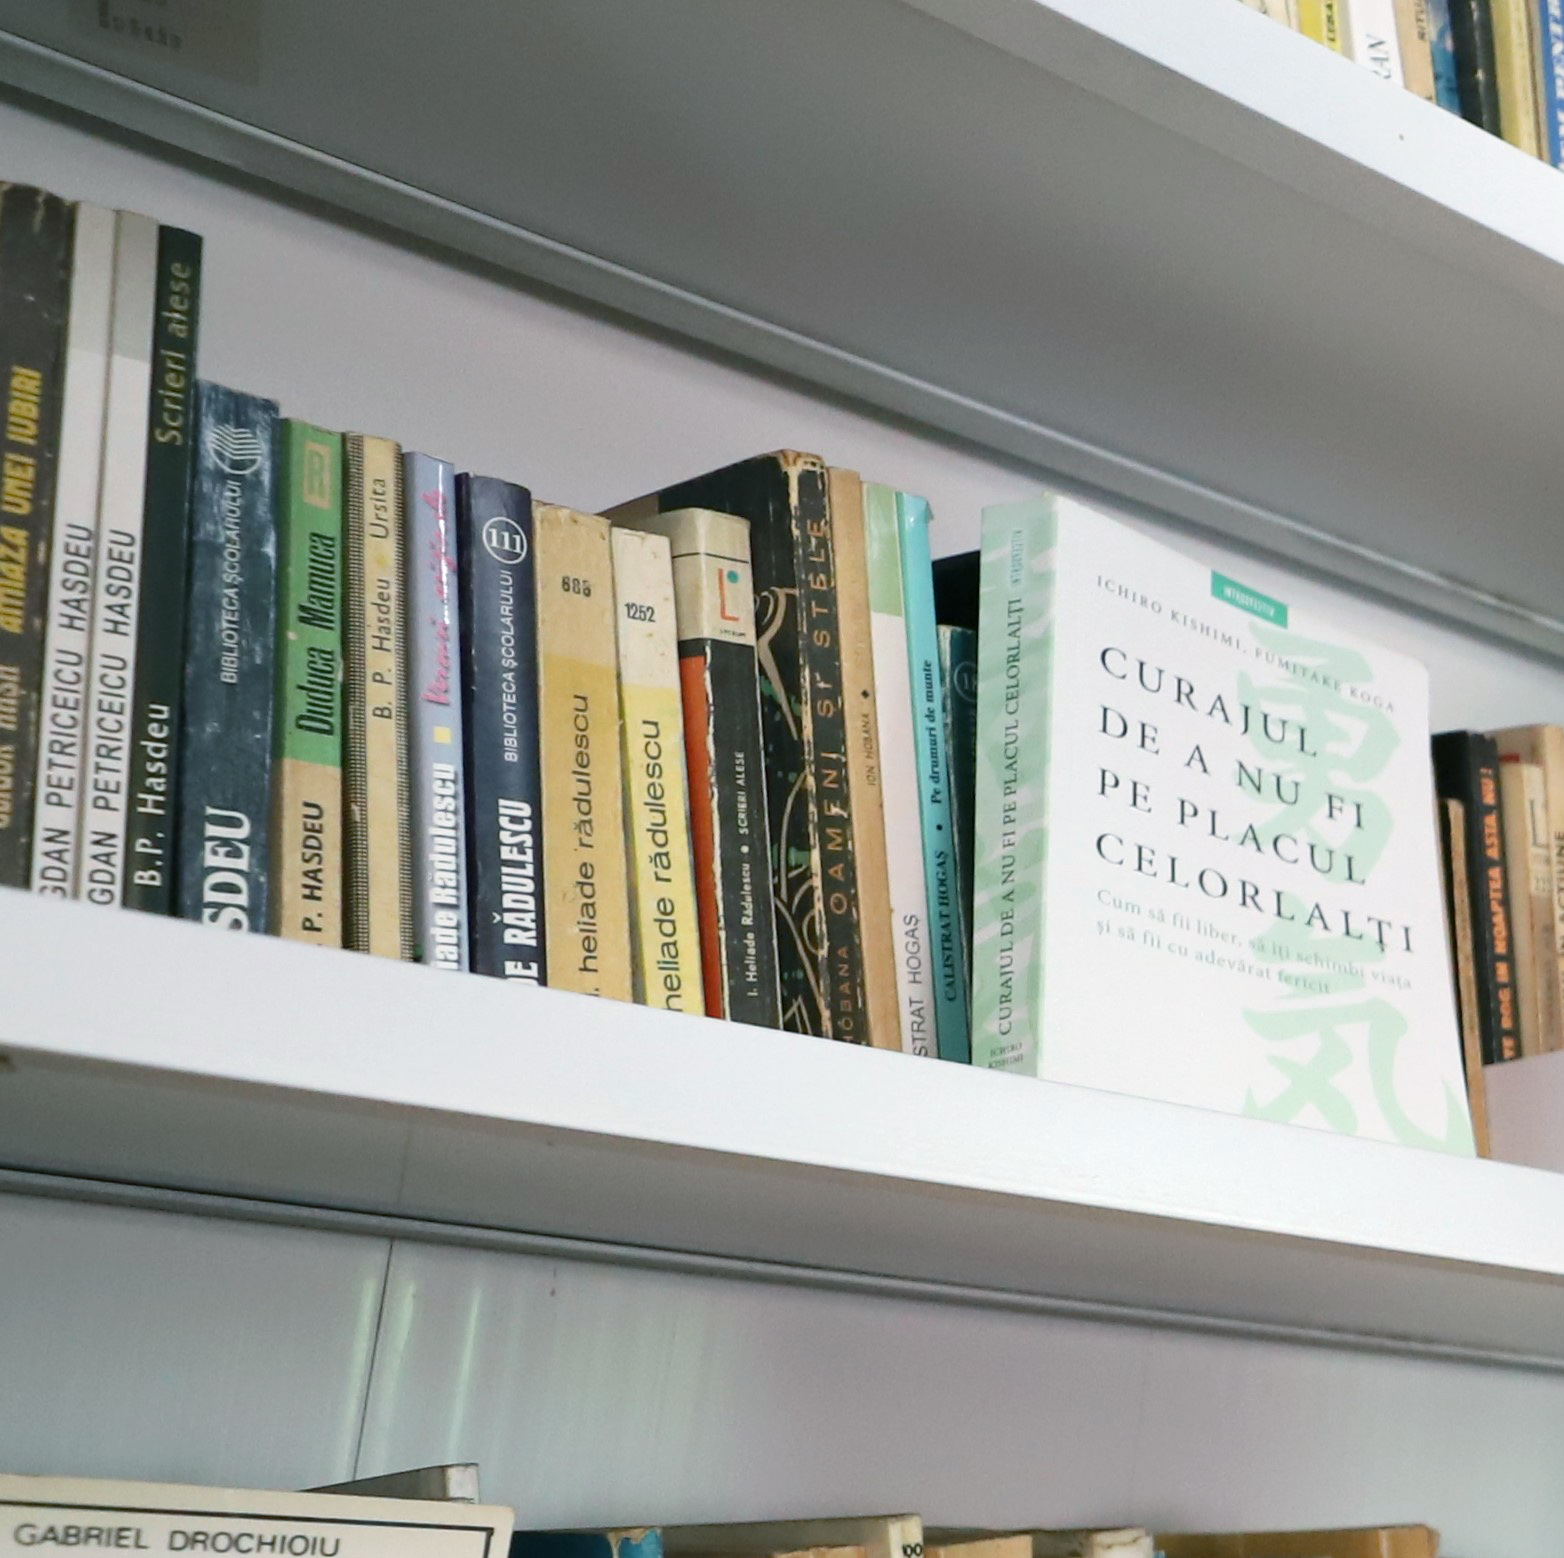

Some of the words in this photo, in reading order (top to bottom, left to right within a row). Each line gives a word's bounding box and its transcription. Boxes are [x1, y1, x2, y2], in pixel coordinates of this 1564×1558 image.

[163, 261, 192, 339] alese
[7, 366, 43, 445] IUBIRI
[154, 350, 187, 446] Scrieri
[367, 477, 390, 540] Ursita
[58, 523, 94, 632] HASDEU
[105, 530, 137, 636] HASDEU
[297, 533, 336, 631] Mamuca
[369, 577, 392, 651] Hasdeu
[623, 601, 658, 624] 1252
[220, 586, 241, 684] BIBLIOTECA
[1097, 574, 1163, 614] ICHIRO
[1254, 647, 1344, 694] FUMITAKE
[1349, 686, 1395, 714] KOGA
[45, 649, 84, 808] PETRICEICU
[94, 655, 130, 811] PETRICEICU
[294, 646, 336, 736] Duduca
[501, 670, 519, 763] BIBLIOTECA
[1099, 645, 1319, 759] CURAJUL
[136, 704, 171, 815] Hasdeu
[569, 693, 595, 850] rădulescu
[640, 718, 674, 884] rădulescu
[733, 749, 748, 787] ALESE
[1001, 718, 1021, 798] PLACUL
[1099, 704, 1160, 756] DE
[1184, 744, 1212, 777] A
[1235, 759, 1301, 807] NU
[1324, 792, 1365, 831] FI
[301, 801, 326, 903] HASDEU
[426, 762, 458, 904] Rădulescu
[736, 789, 750, 835] SCRIERI
[823, 750, 850, 916] OAMENI
[1001, 800, 1018, 826] PE
[1001, 831, 1017, 850] FI
[1098, 767, 1152, 814] PE
[1176, 797, 1367, 886] PLACUL
[89, 829, 121, 906] GDAN
[491, 798, 536, 946] RĂDULESCU
[998, 886, 1016, 904] A
[999, 854, 1017, 885] NU
[1095, 832, 1414, 953] CELORLALȚI
[1098, 888, 1142, 918] Cum
[574, 861, 599, 974] heliade
[652, 895, 687, 1011] heliade
[901, 913, 924, 985] HOGAȘ
[999, 907, 1017, 937] DE
[1166, 939, 1189, 955] cu
[907, 995, 929, 1057] STRAT
[997, 940, 1017, 1036] CURAJUL
[14, 1521, 149, 1550] GABRIEL
